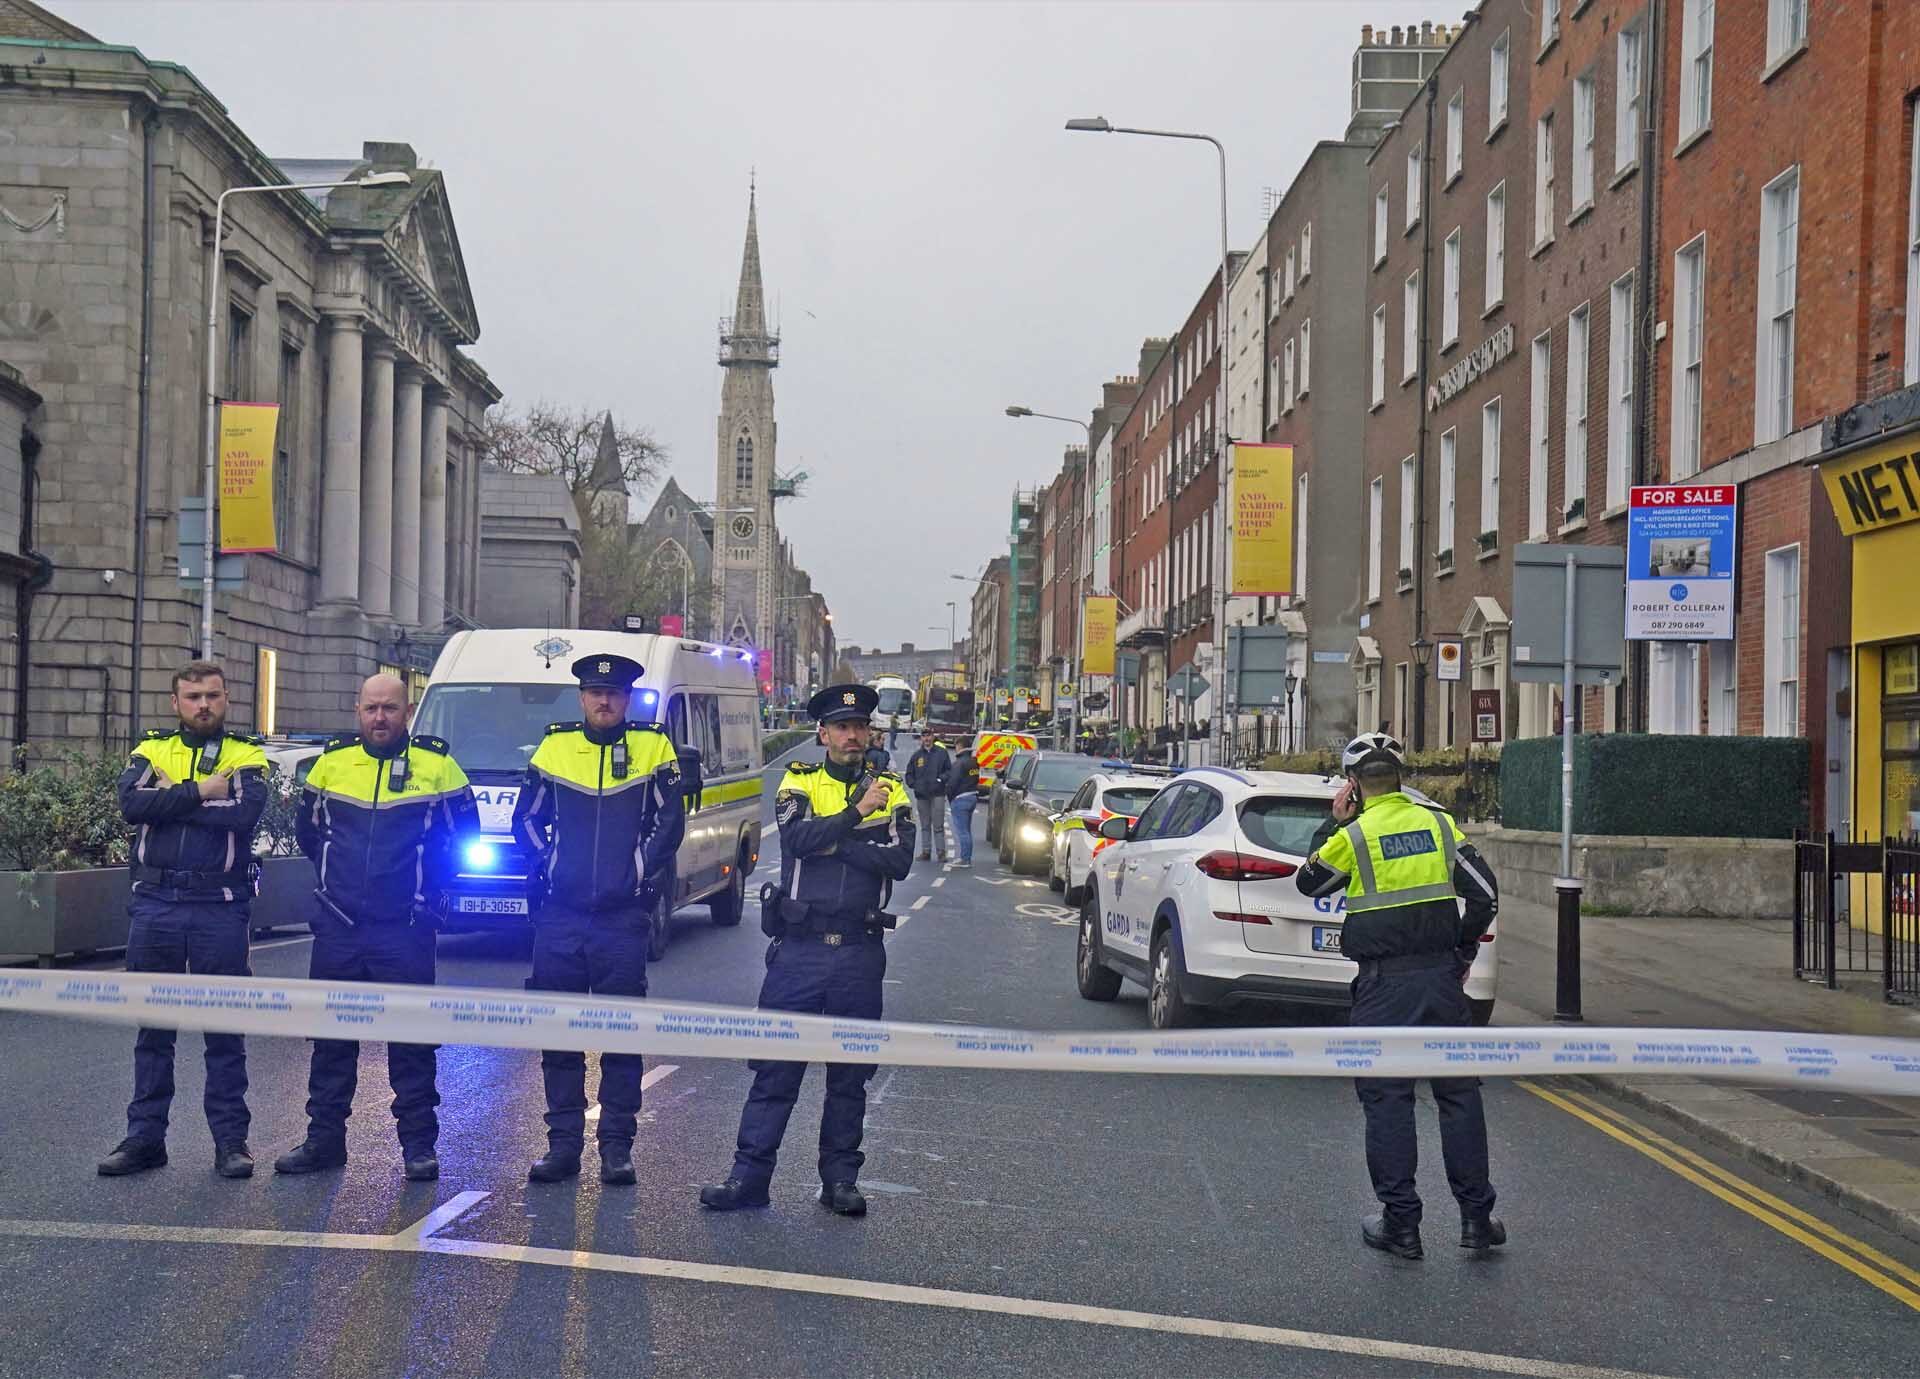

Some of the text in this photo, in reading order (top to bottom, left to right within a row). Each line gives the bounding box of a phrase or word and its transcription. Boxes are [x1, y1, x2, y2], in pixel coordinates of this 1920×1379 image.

[1642, 489, 1723, 504] FOR SALE
[1632, 604, 1725, 612] ROBERT COLLERAN
[1684, 621, 1705, 629] 6849
[1382, 836, 1434, 857] GARDA
[464, 901, 522, 914] 191-D-30557
[1106, 911, 1130, 937] GARDA
[832, 1031, 890, 1042] Confidential
[841, 1043, 880, 1052] GARDA
[1336, 1059, 1373, 1068] GARDA
